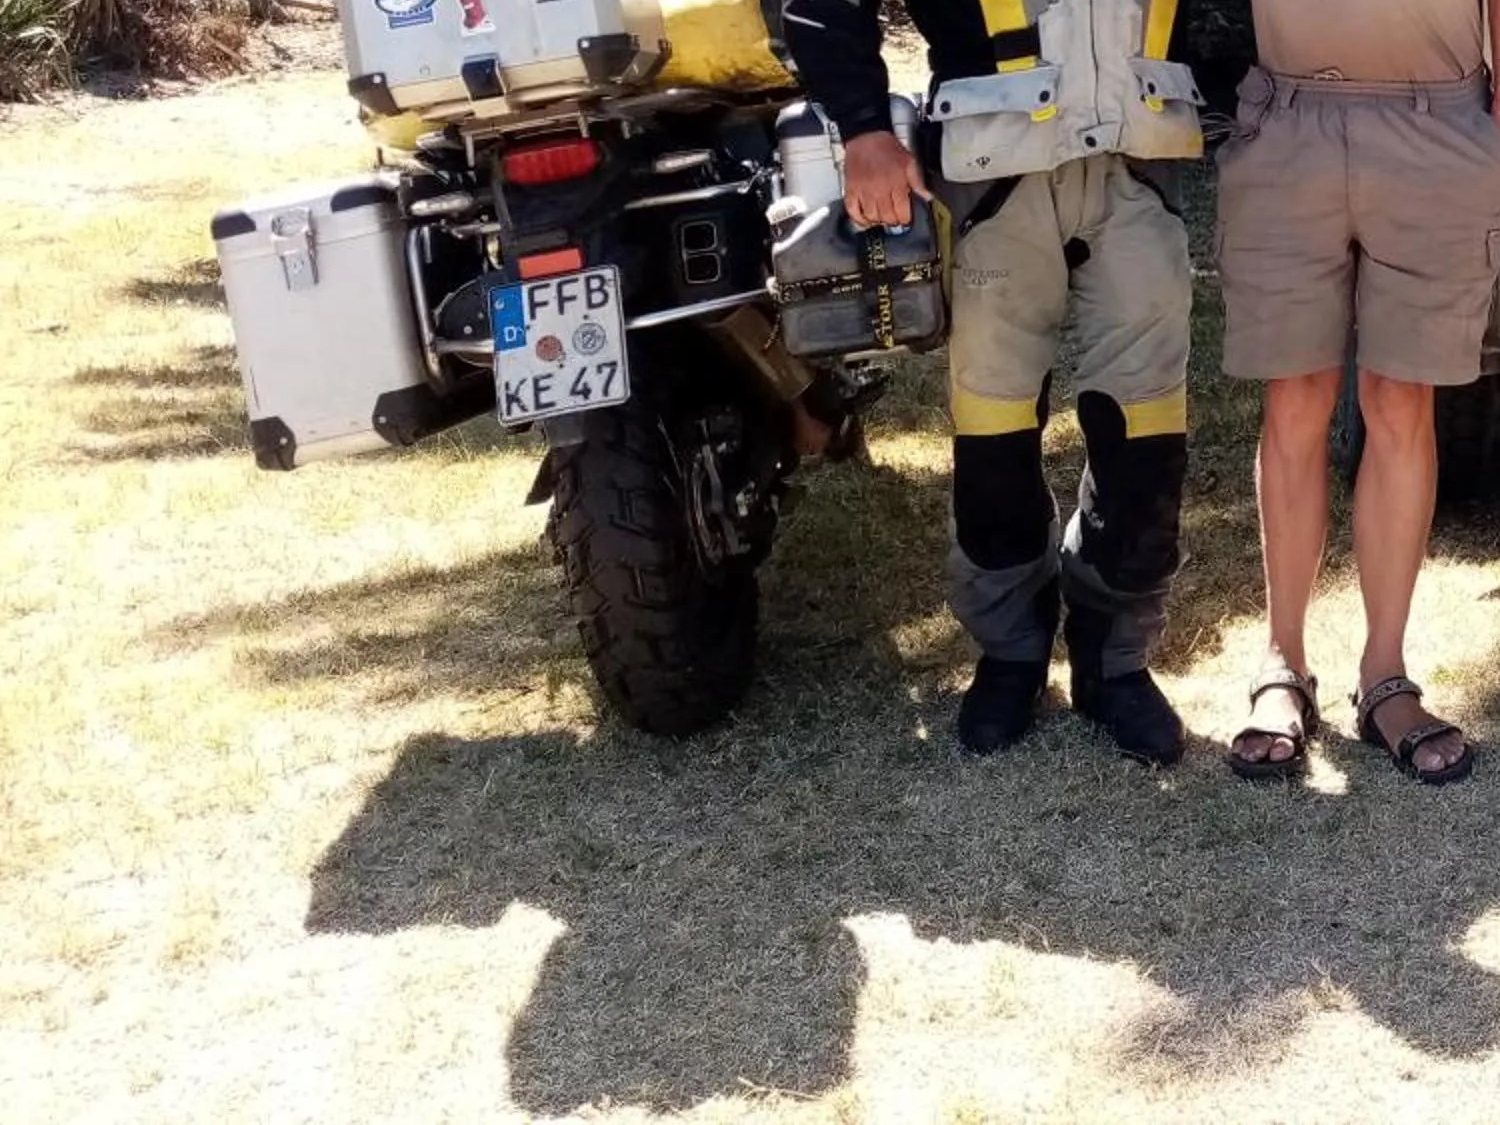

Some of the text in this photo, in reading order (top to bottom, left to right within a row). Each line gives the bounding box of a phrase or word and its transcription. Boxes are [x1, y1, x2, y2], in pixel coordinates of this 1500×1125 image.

[527, 274, 610, 321] FFB
[503, 325, 518, 343] D
[504, 360, 619, 416] KE 47
